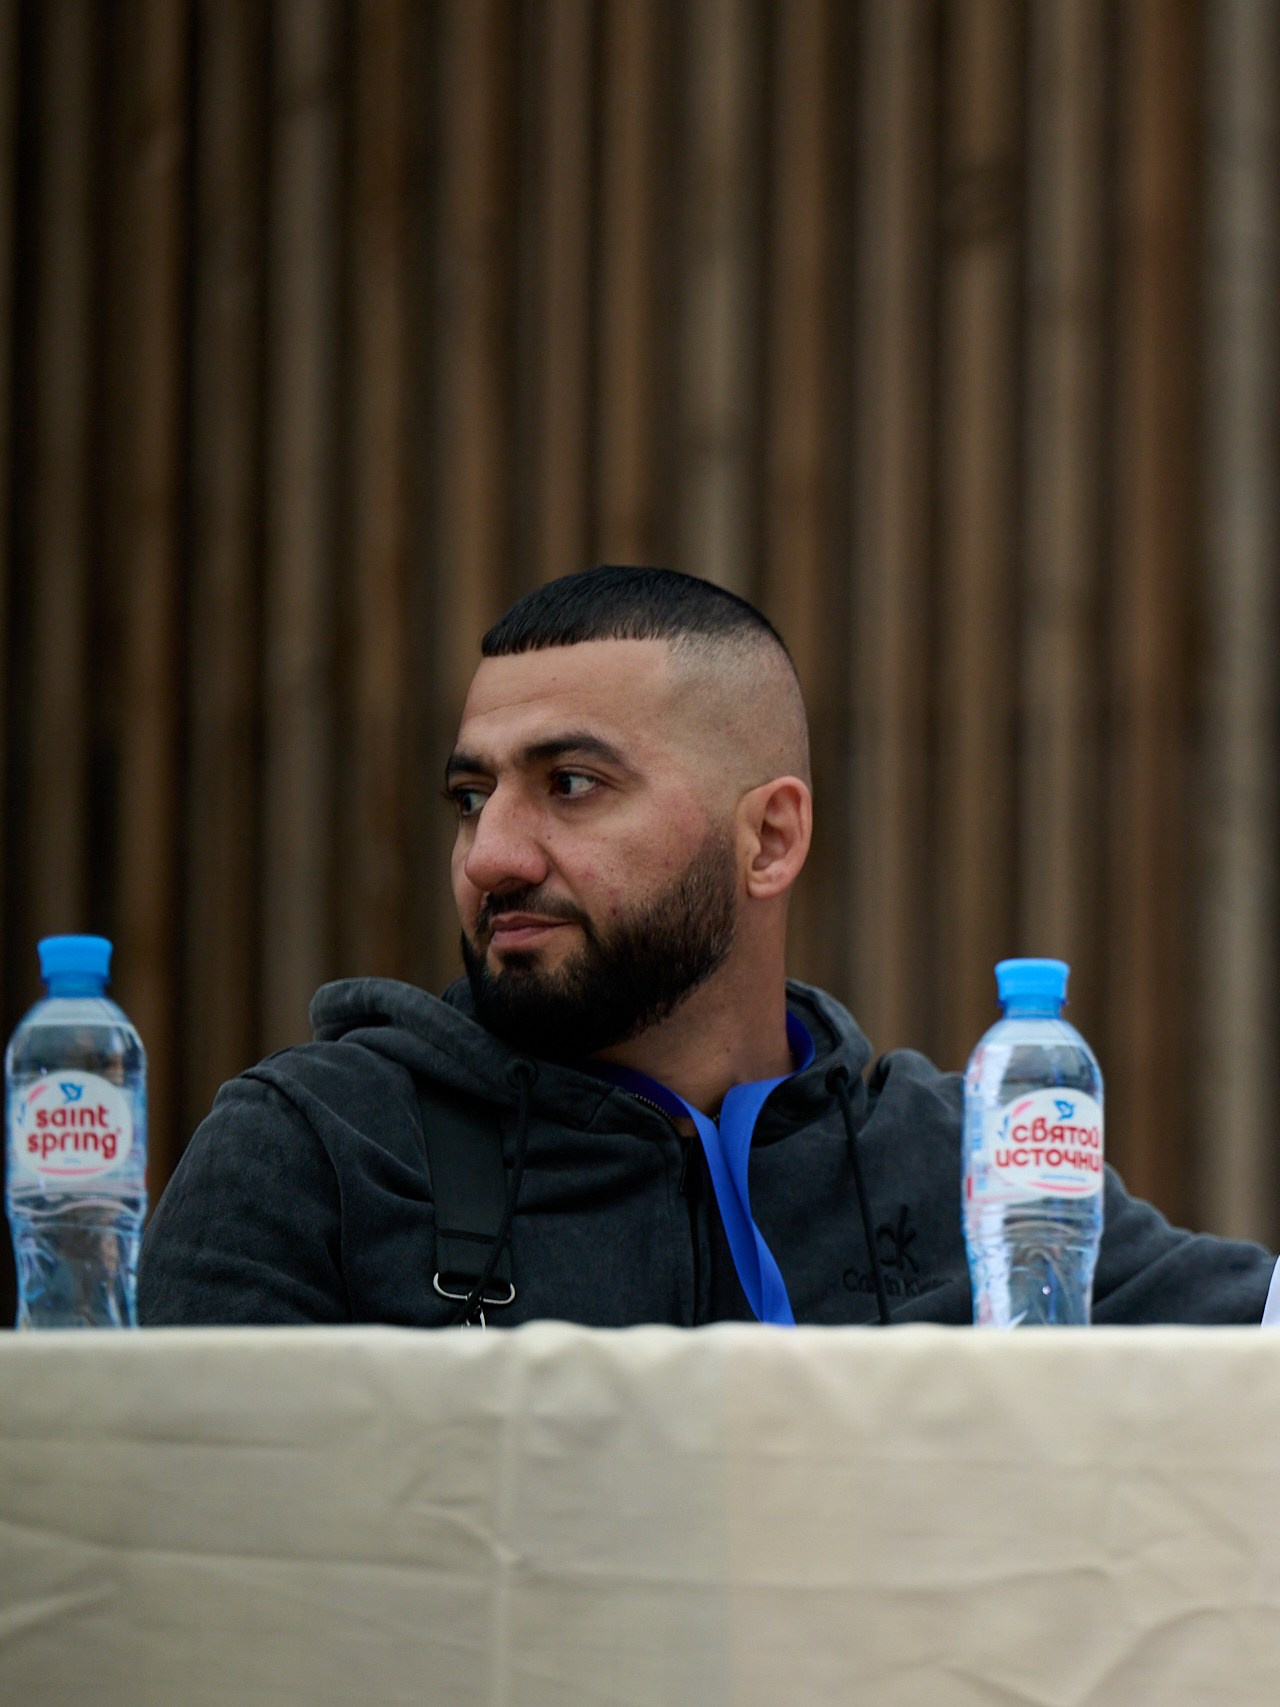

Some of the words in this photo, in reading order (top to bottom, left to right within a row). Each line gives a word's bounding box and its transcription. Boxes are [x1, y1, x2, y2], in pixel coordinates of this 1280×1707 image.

[36, 1104, 109, 1128] saint
[27, 1131, 117, 1160] spring
[995, 1148, 1101, 1172] источни
